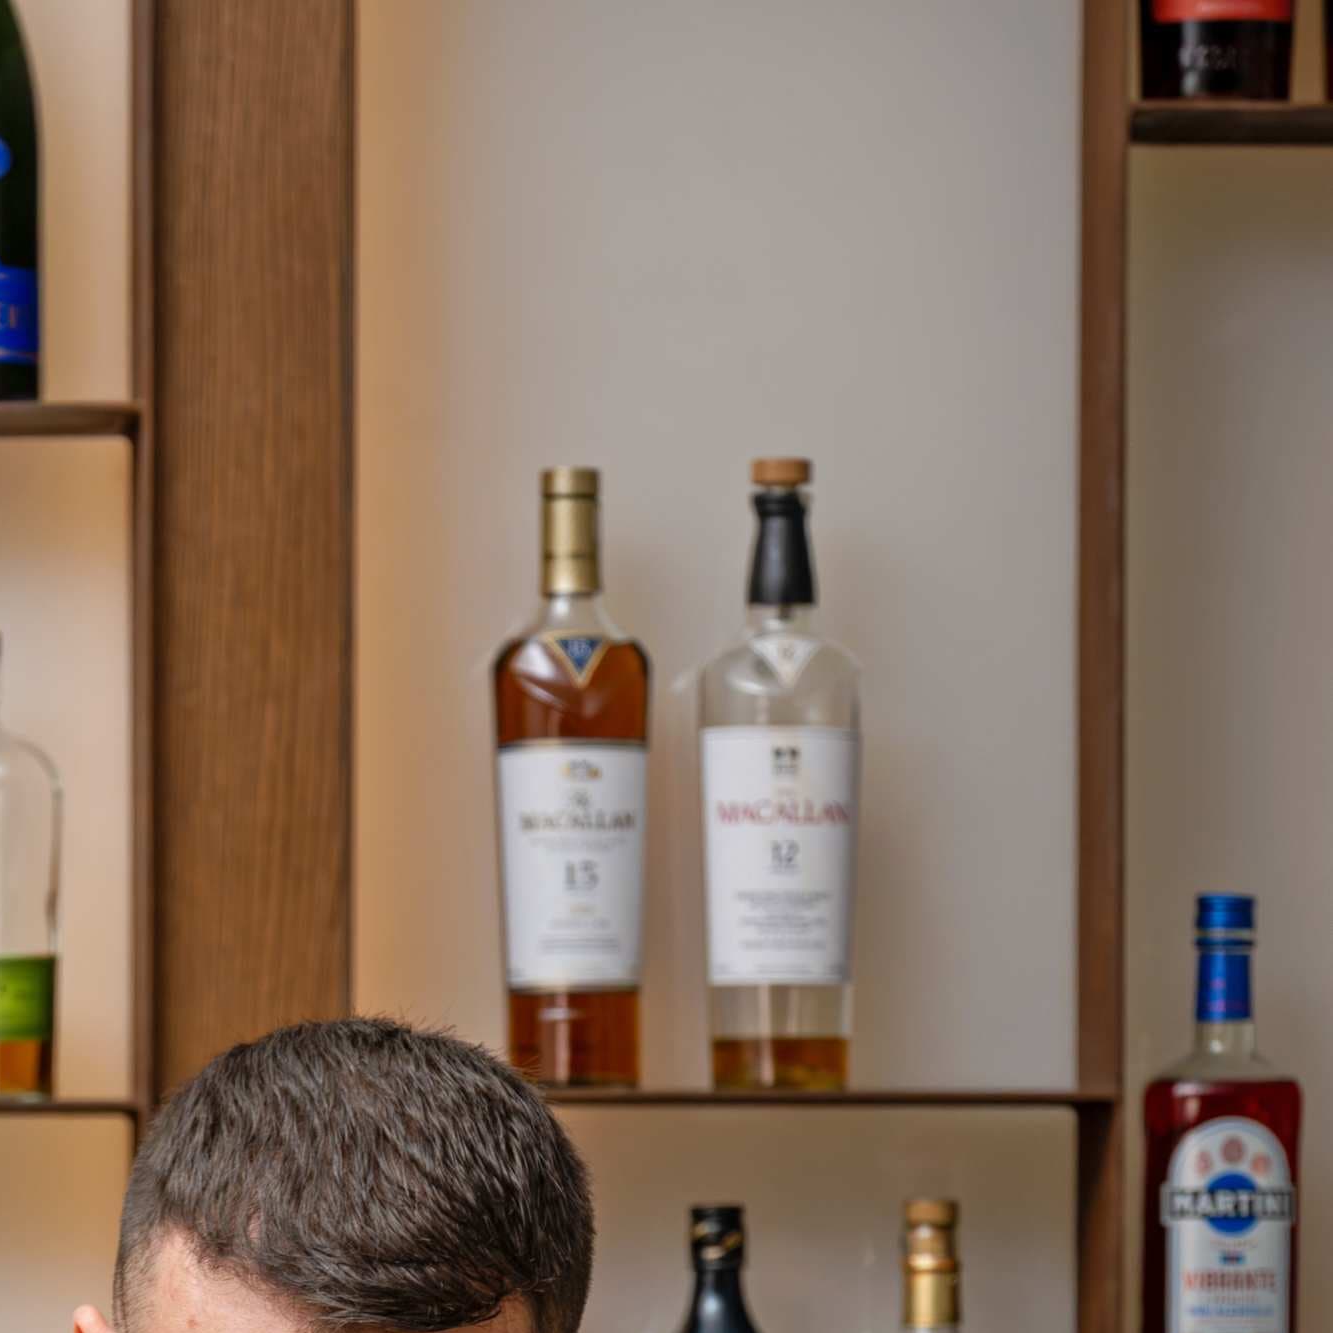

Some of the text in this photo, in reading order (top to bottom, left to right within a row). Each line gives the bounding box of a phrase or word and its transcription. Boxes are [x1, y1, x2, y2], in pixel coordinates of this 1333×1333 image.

[520, 809, 637, 833] MACALLAN
[717, 799, 851, 826] MACALLAN
[771, 840, 800, 868] 12
[565, 860, 600, 891] 15
